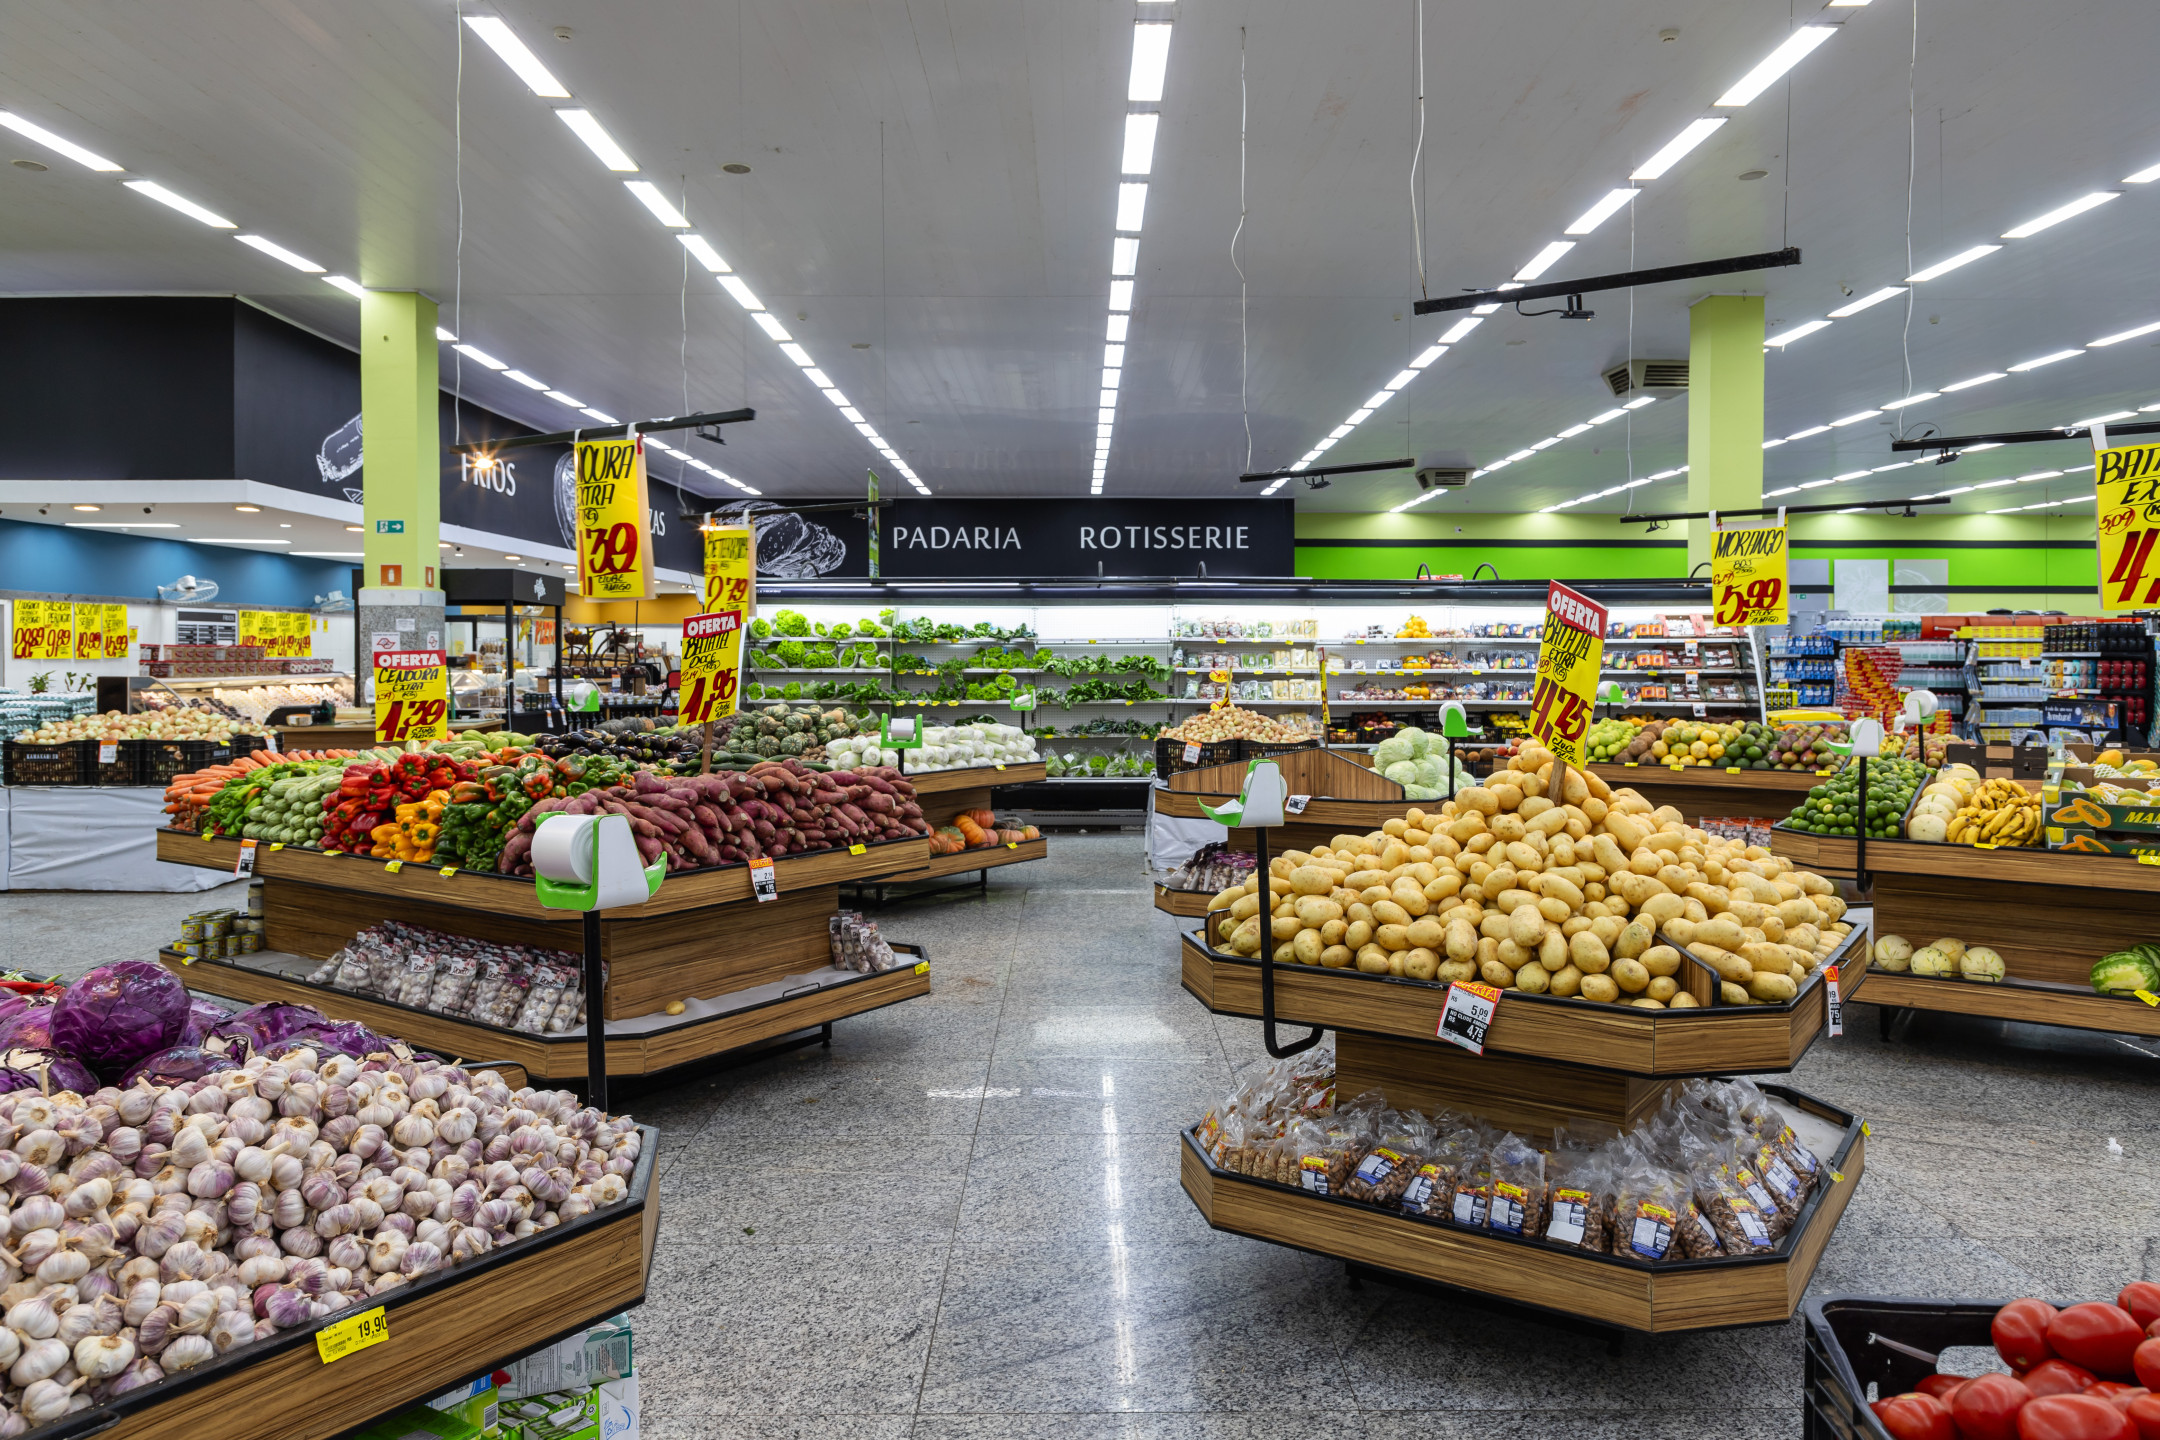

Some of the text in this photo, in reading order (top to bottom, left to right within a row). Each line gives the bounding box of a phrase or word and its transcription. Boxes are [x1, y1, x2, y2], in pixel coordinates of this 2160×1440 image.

[461, 452, 516, 496] FRIOS
[2099, 511, 2133, 534] 5,09
[893, 526, 1250, 550] PADARIA ROTISSERIE
[1714, 529, 1784, 559] MORANGO
[1716, 577, 1782, 625] 5,99
[1550, 590, 1600, 637] OFERTA
[687, 615, 736, 636] OFERTA
[1542, 611, 1593, 661] BATATA
[684, 631, 730, 660] BATATA
[379, 653, 441, 667] OFERTA
[1549, 650, 1577, 669] EXTRA
[378, 667, 439, 684] CENOURA
[392, 683, 424, 692] EXTRA
[681, 667, 738, 723] 1,95
[376, 699, 446, 741] 1,39
[2124, 811, 2160, 824] MA
[1455, 980, 1497, 1002] OFERTA
[1471, 1004, 1489, 1019] 5,09
[1466, 1024, 1484, 1040] 4,75
[358, 1314, 387, 1338] 19,90
